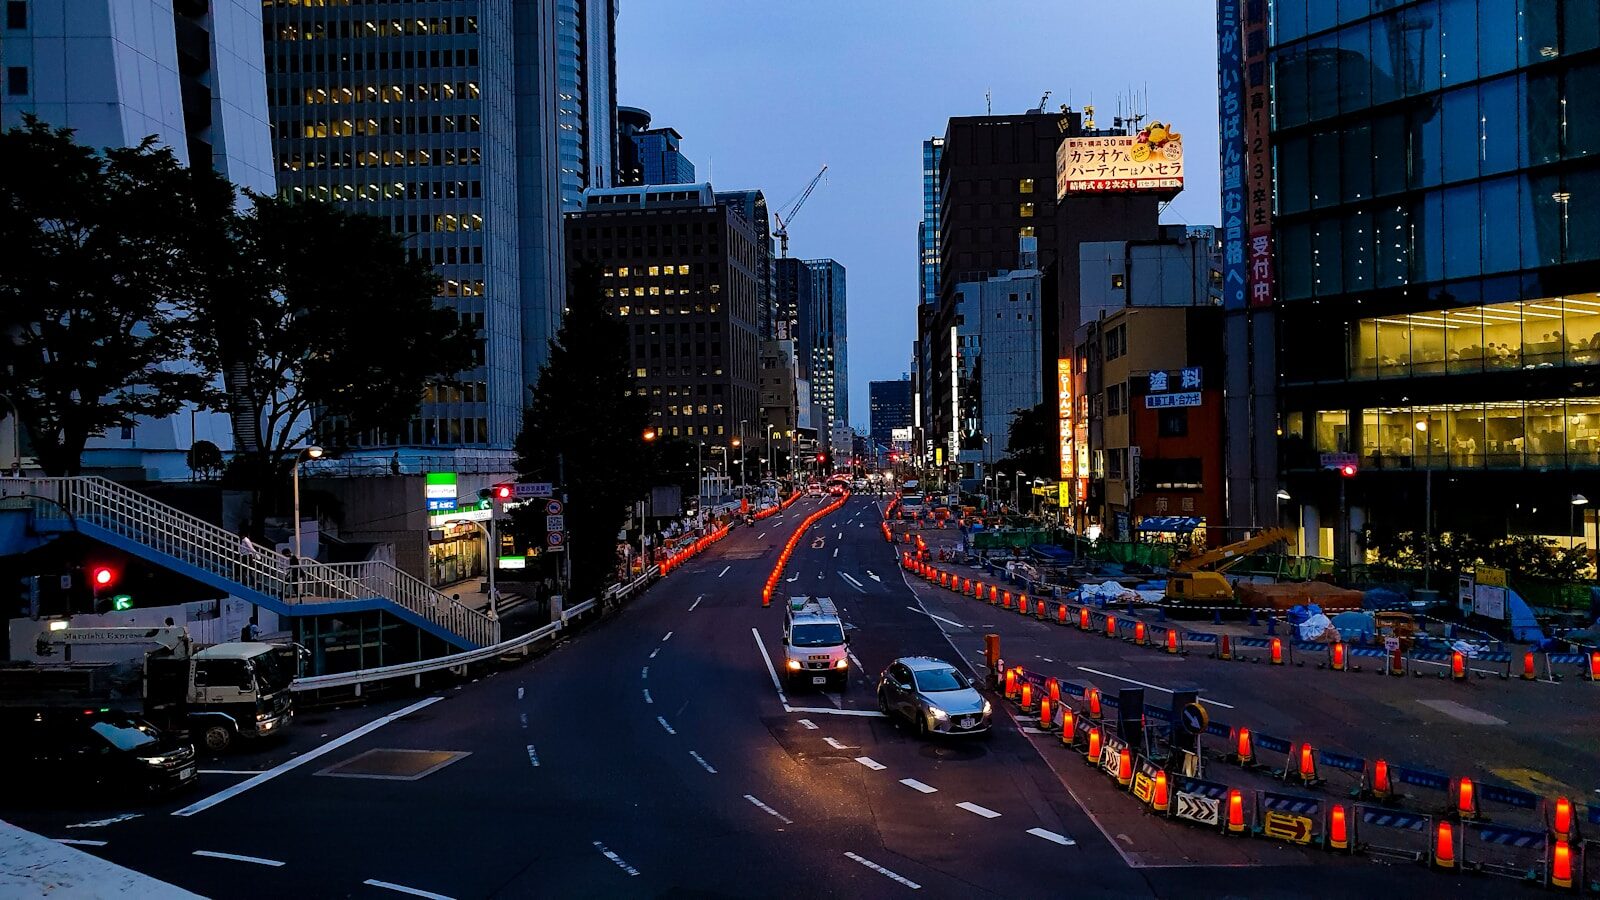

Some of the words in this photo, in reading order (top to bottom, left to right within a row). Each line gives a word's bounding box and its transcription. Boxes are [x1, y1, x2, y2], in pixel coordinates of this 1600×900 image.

[1222, 0, 1244, 302] ミが、いちばん望む合格へ。
[1070, 162, 1182, 177] パーティーはパセラ
[1252, 235, 1270, 302] 受付中
[1149, 367, 1201, 391] 塗料
[1144, 517, 1196, 526] ペイント
[64, 632, 105, 640] Maruishi
[107, 633, 142, 641] Express
